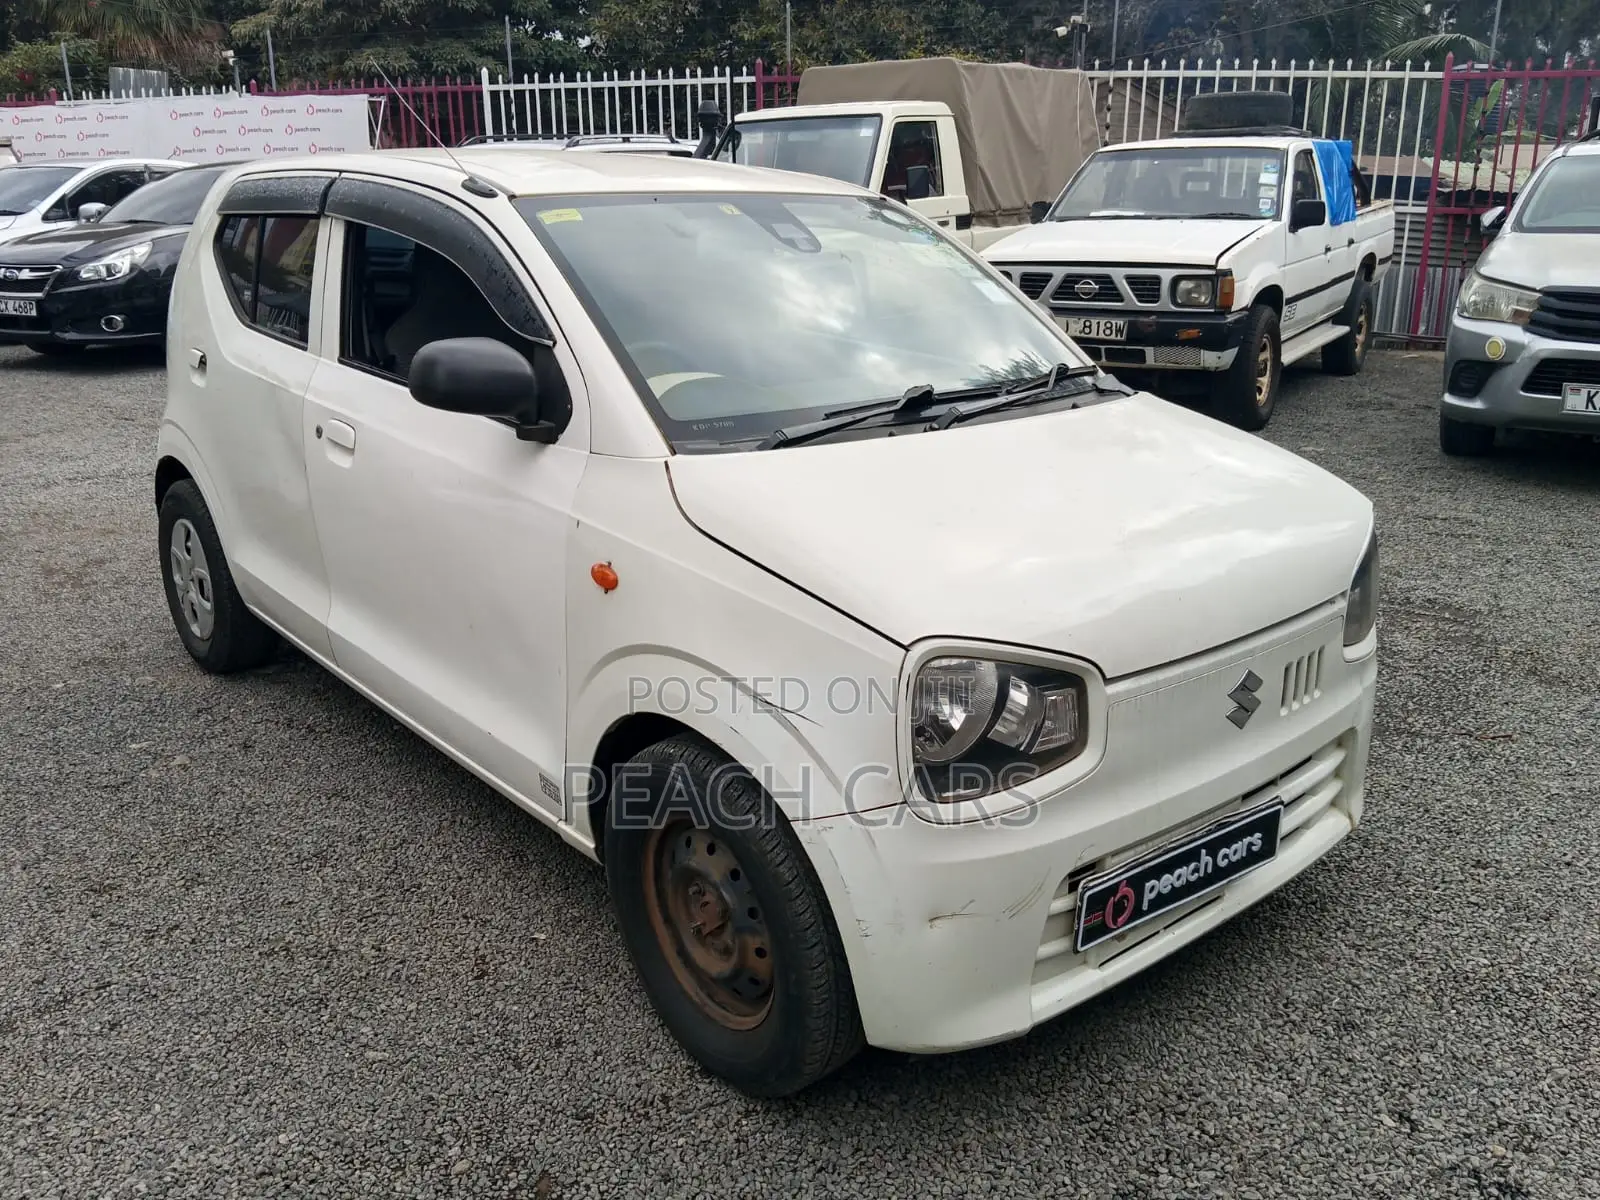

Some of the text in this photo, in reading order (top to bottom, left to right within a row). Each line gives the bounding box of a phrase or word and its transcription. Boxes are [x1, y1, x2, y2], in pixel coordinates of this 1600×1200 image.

[13, 301, 34, 314] 468P
[1082, 319, 1127, 338] 818W
[1585, 390, 1600, 410] K
[1142, 832, 1262, 910] peach cars
